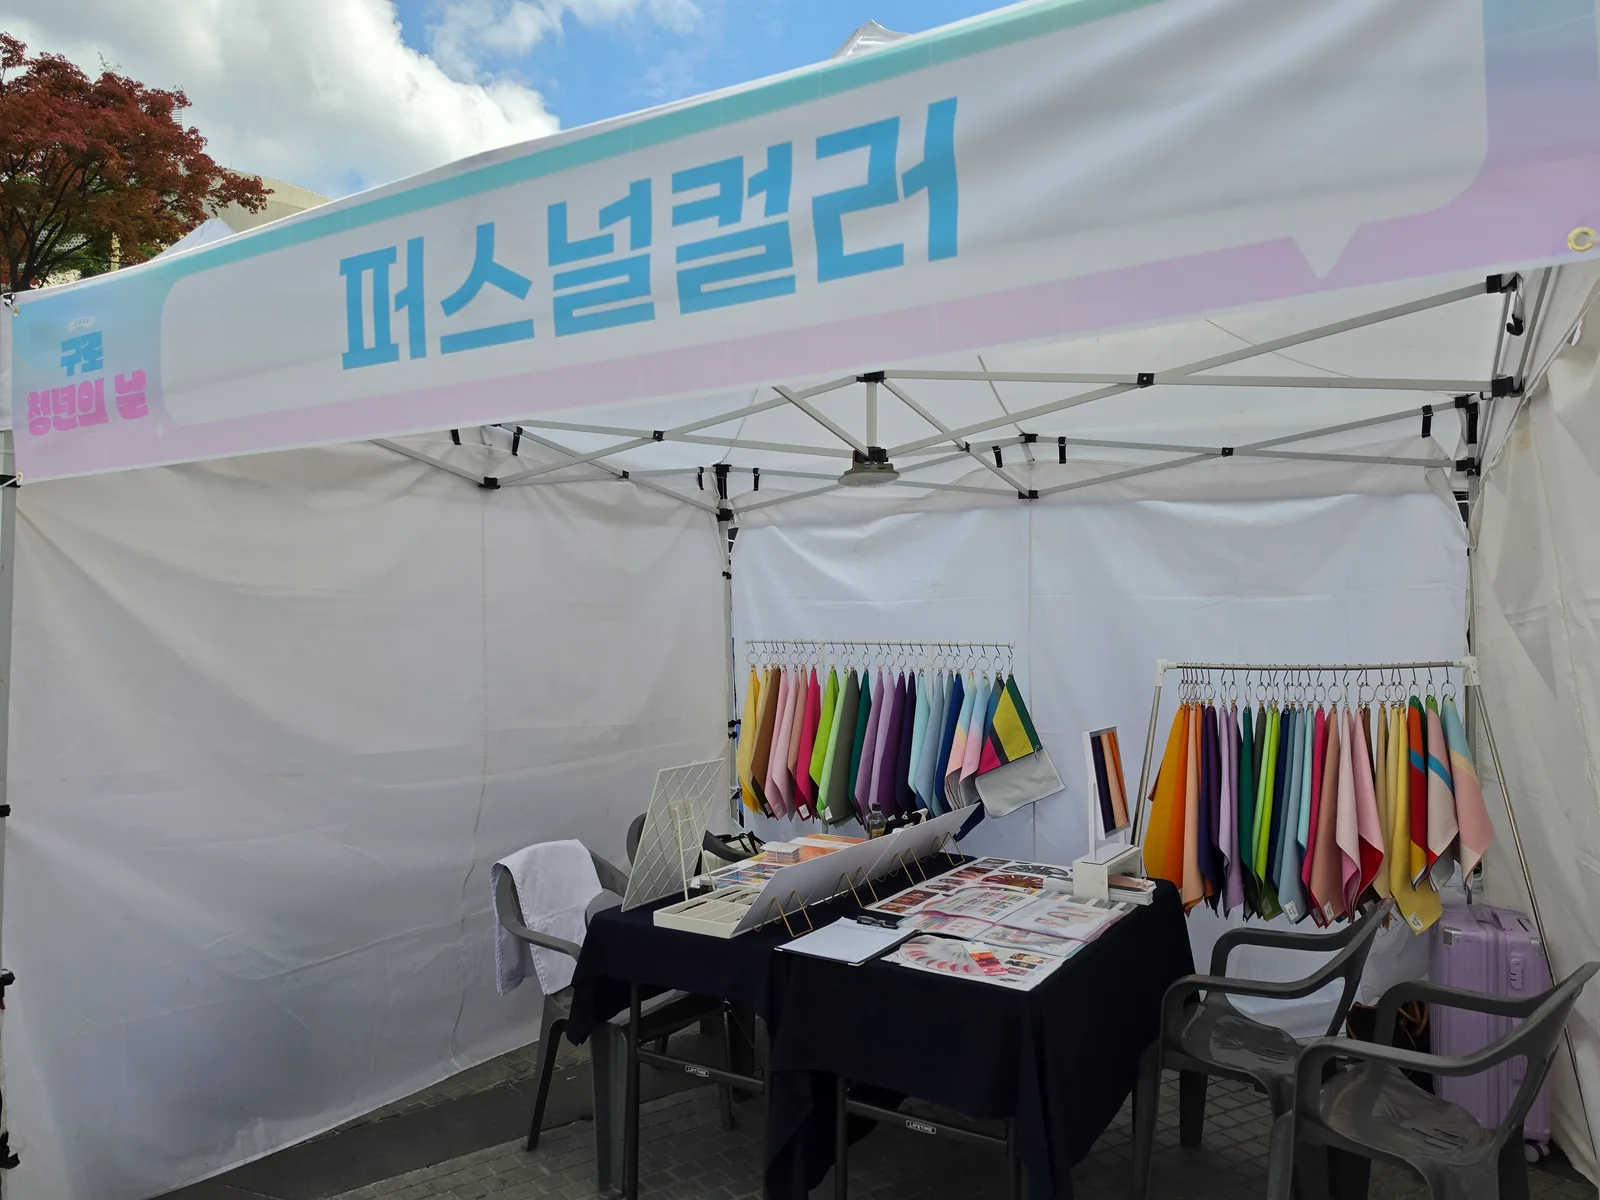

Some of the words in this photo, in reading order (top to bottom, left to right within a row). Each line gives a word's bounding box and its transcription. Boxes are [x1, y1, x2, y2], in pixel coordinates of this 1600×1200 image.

[340, 97, 959, 370] 퍼스널컬러
[60, 331, 104, 377] 구로
[27, 377, 109, 436] 청년의
[114, 369, 149, 420] 날
[908, 1121, 934, 1133] LIFETIME
